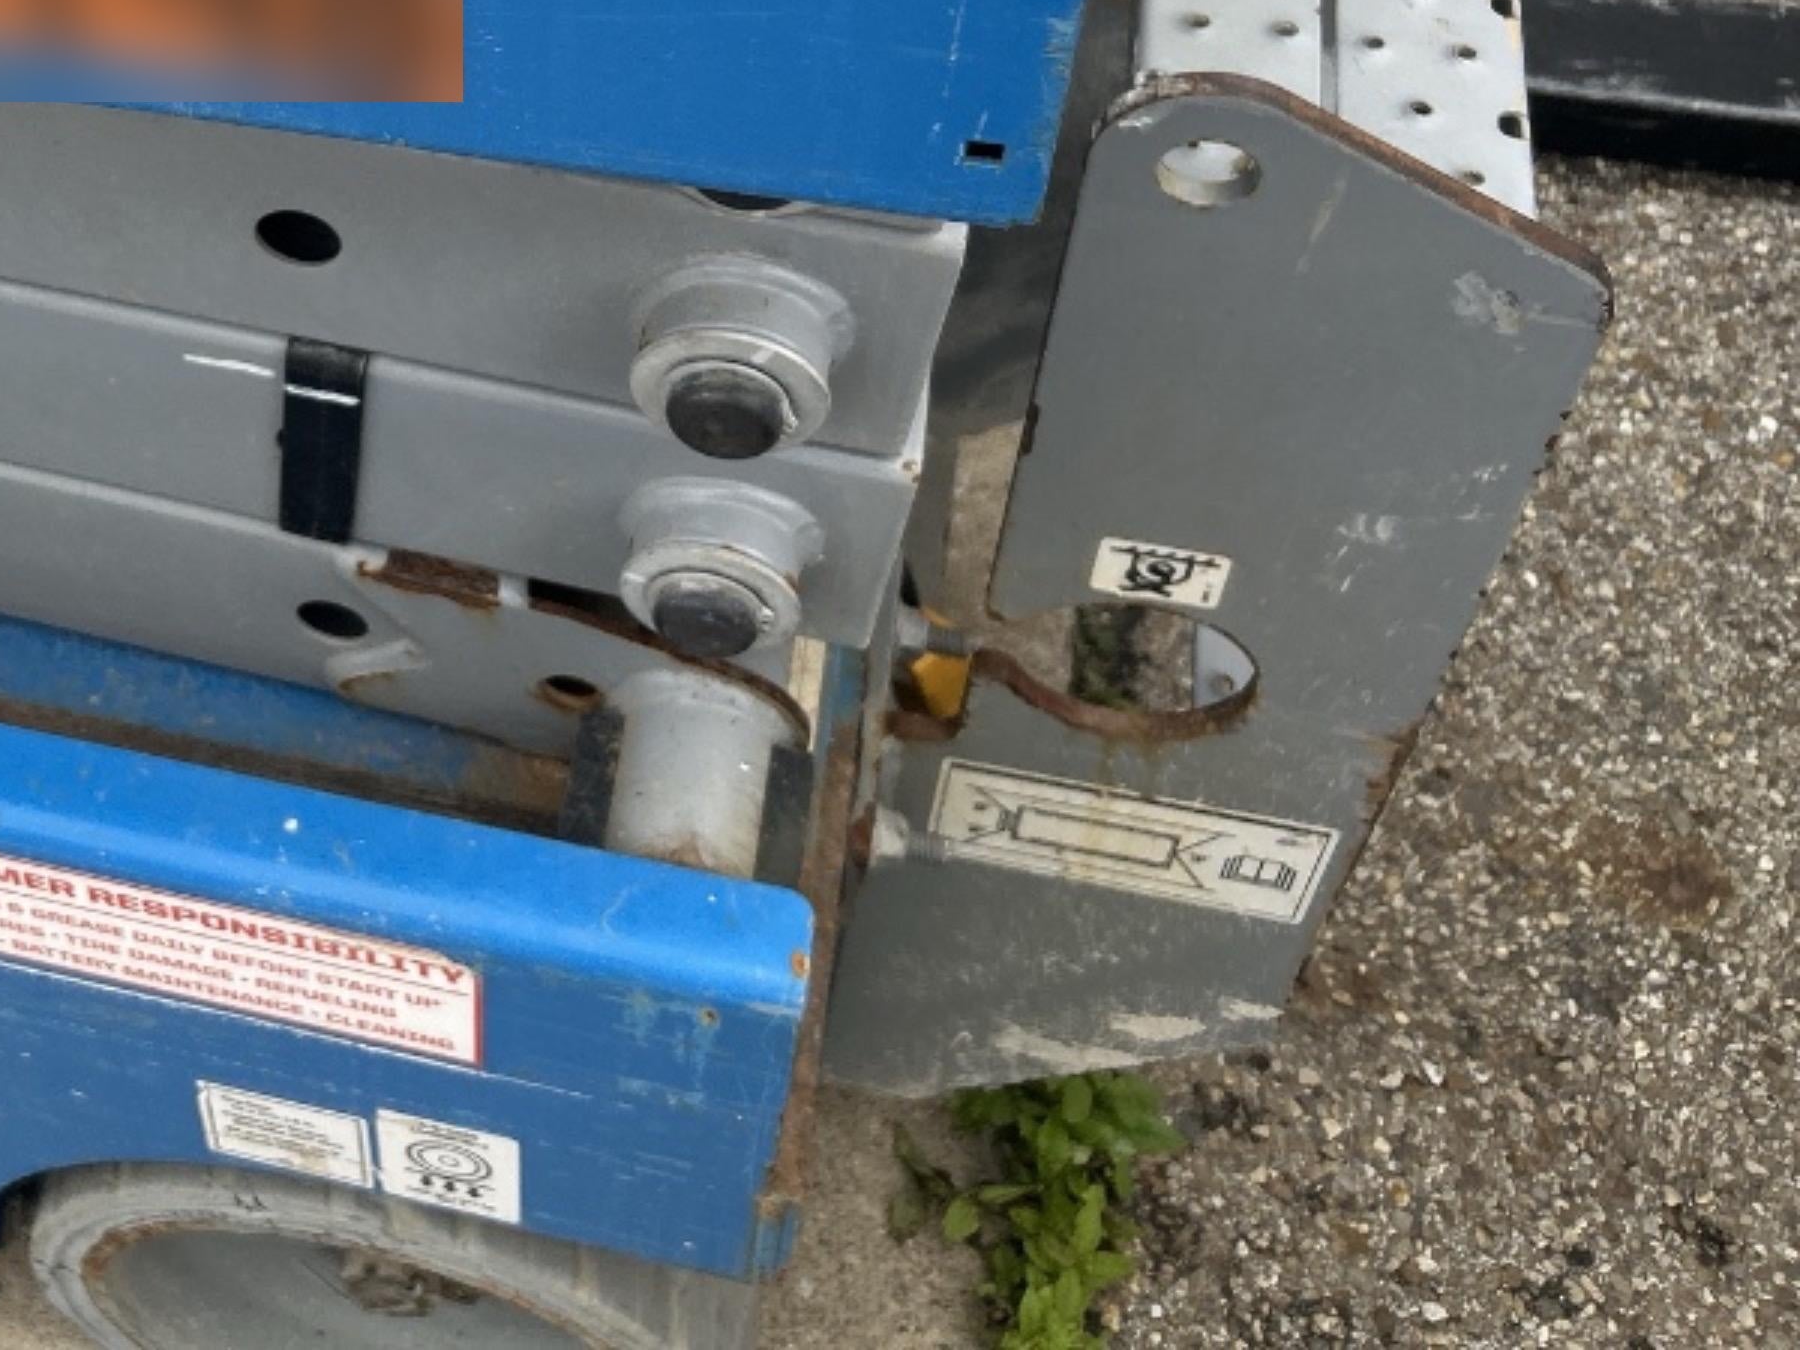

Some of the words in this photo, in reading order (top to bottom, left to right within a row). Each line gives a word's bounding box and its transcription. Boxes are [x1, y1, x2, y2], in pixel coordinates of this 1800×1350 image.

[31, 906, 125, 937] GREASE
[132, 928, 204, 955] DAILY
[212, 949, 310, 980] BEFORE
[316, 972, 398, 1000] START
[65, 932, 121, 955] TIRE
[129, 948, 234, 982] DAMAGE
[255, 976, 397, 1019] REFUELING
[86, 883, 465, 984] RESPONSIBILITY
[120, 964, 305, 1016] MAINTENANCE
[325, 1011, 456, 1051] CLEANING
